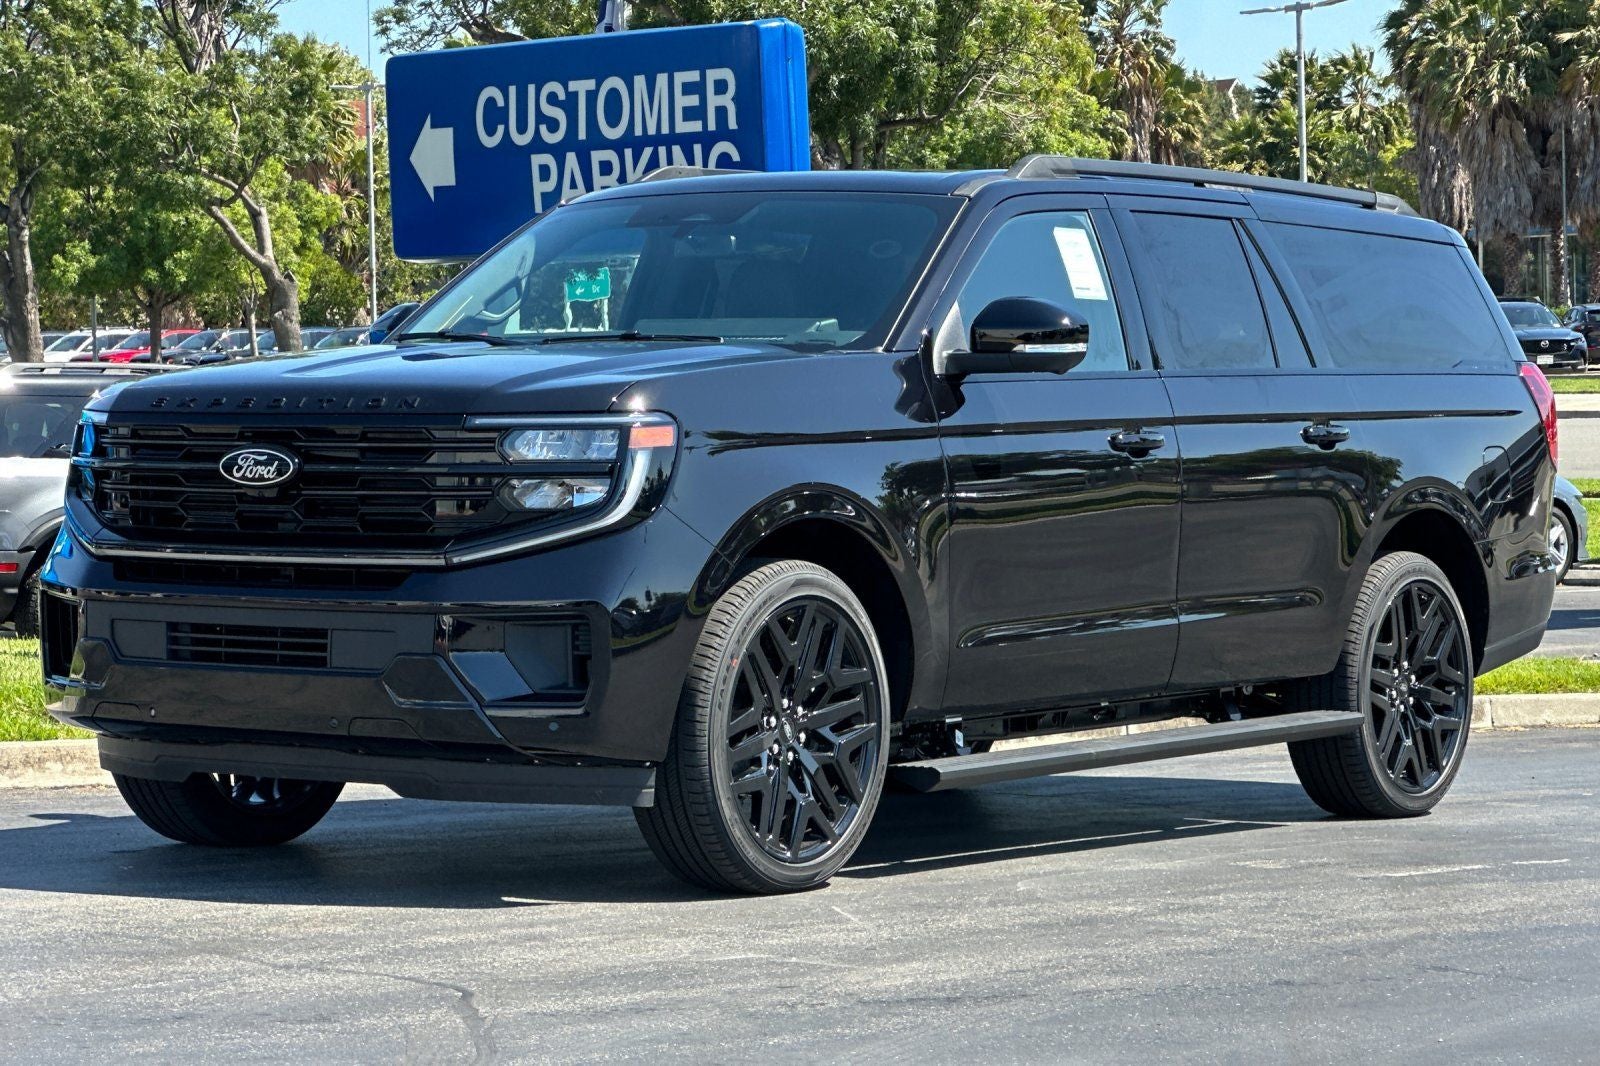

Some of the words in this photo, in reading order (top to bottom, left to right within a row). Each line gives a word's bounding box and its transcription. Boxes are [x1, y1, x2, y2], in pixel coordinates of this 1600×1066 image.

[475, 67, 739, 149] CUSTOMER
[150, 396, 421, 409] EXPEDITION
[232, 453, 279, 479] Ford
